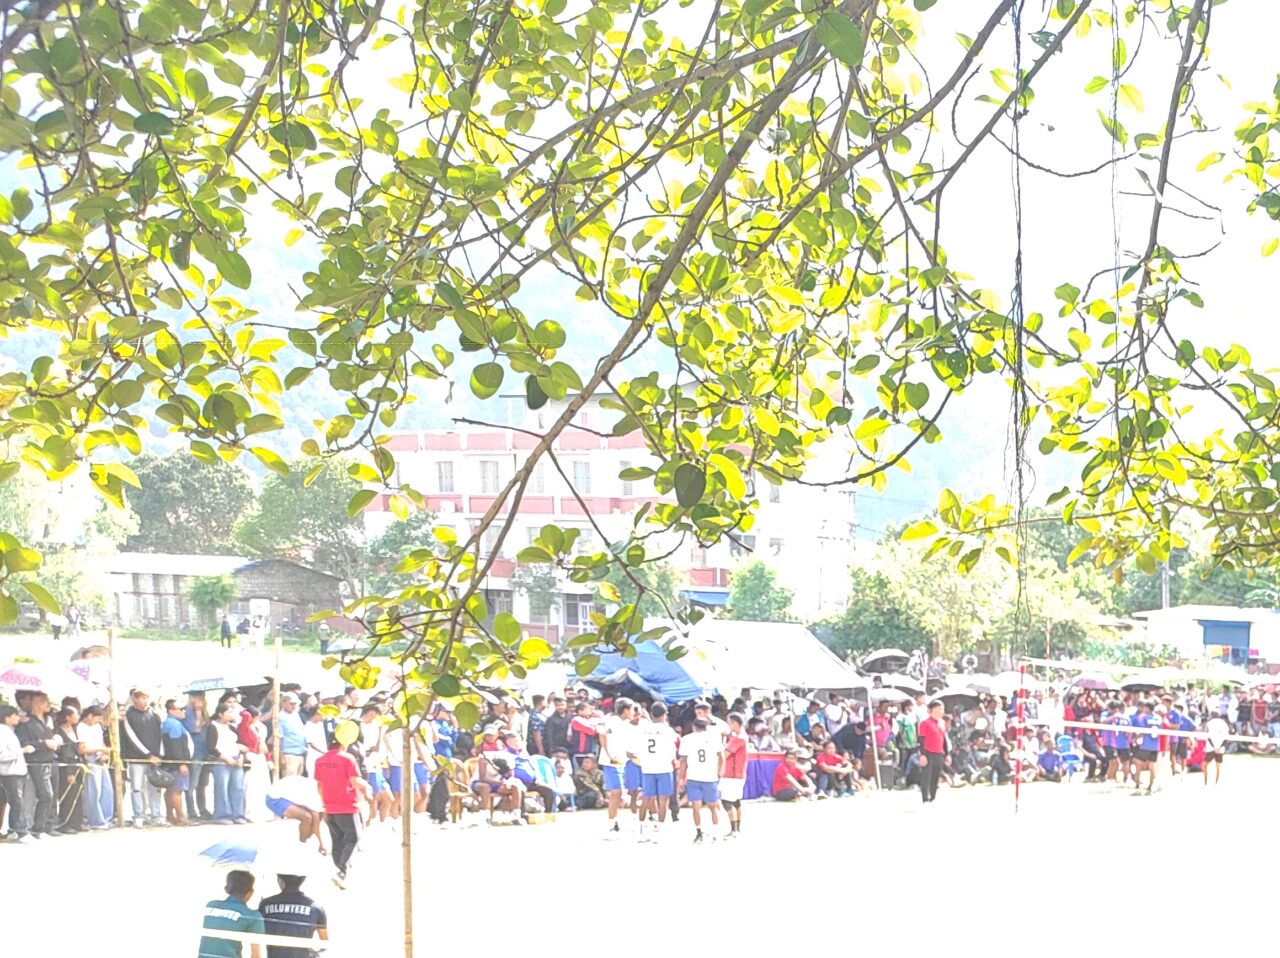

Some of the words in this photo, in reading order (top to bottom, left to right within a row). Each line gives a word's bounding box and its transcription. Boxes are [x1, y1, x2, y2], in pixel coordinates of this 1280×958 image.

[647, 738, 657, 754] 2
[697, 748, 706, 763] 8
[265, 903, 311, 916] VOLUNTEER
